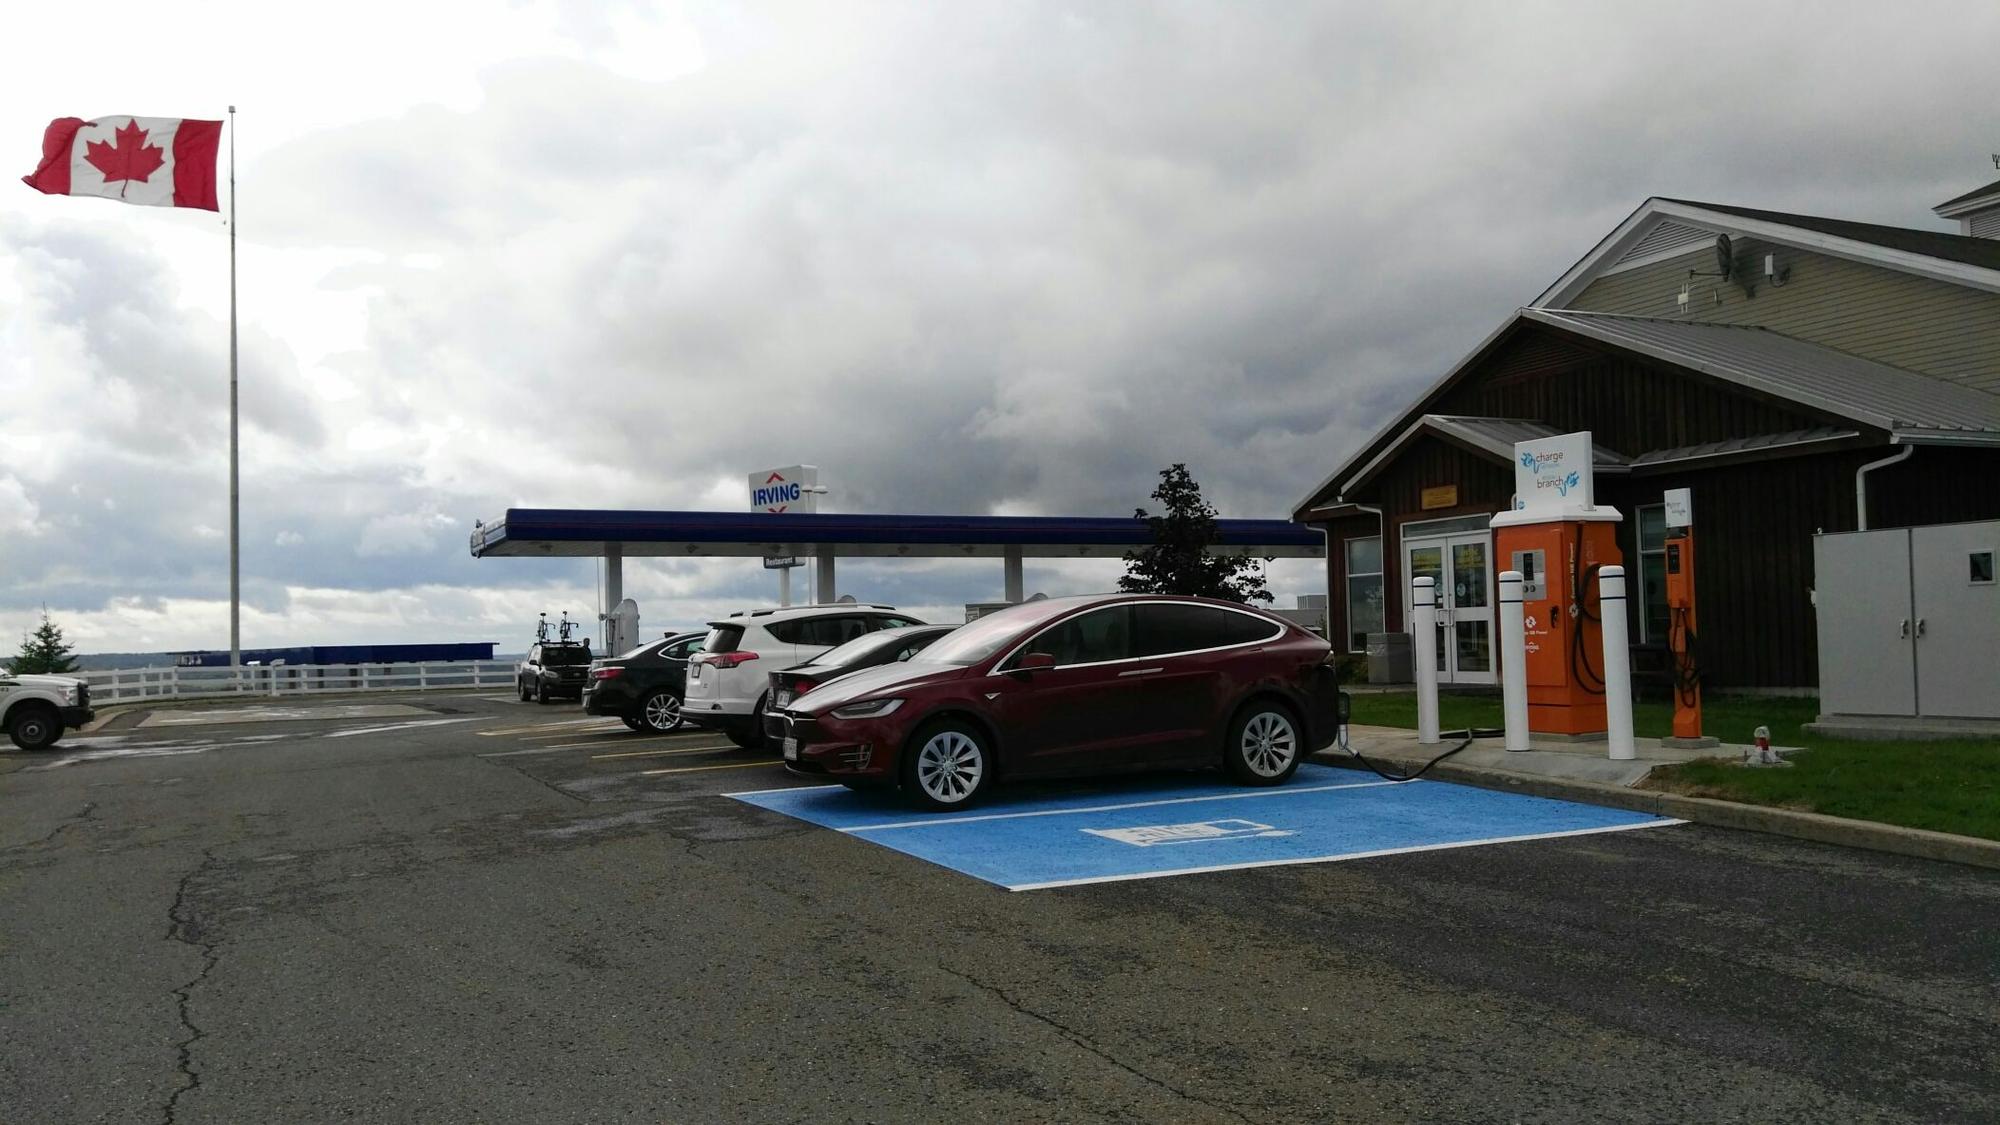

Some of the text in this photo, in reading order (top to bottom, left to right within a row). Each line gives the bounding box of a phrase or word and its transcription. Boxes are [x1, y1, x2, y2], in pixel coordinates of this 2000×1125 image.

[1536, 452, 1564, 463] charge
[1537, 476, 1564, 489] branch
[753, 483, 800, 506] IRVING
